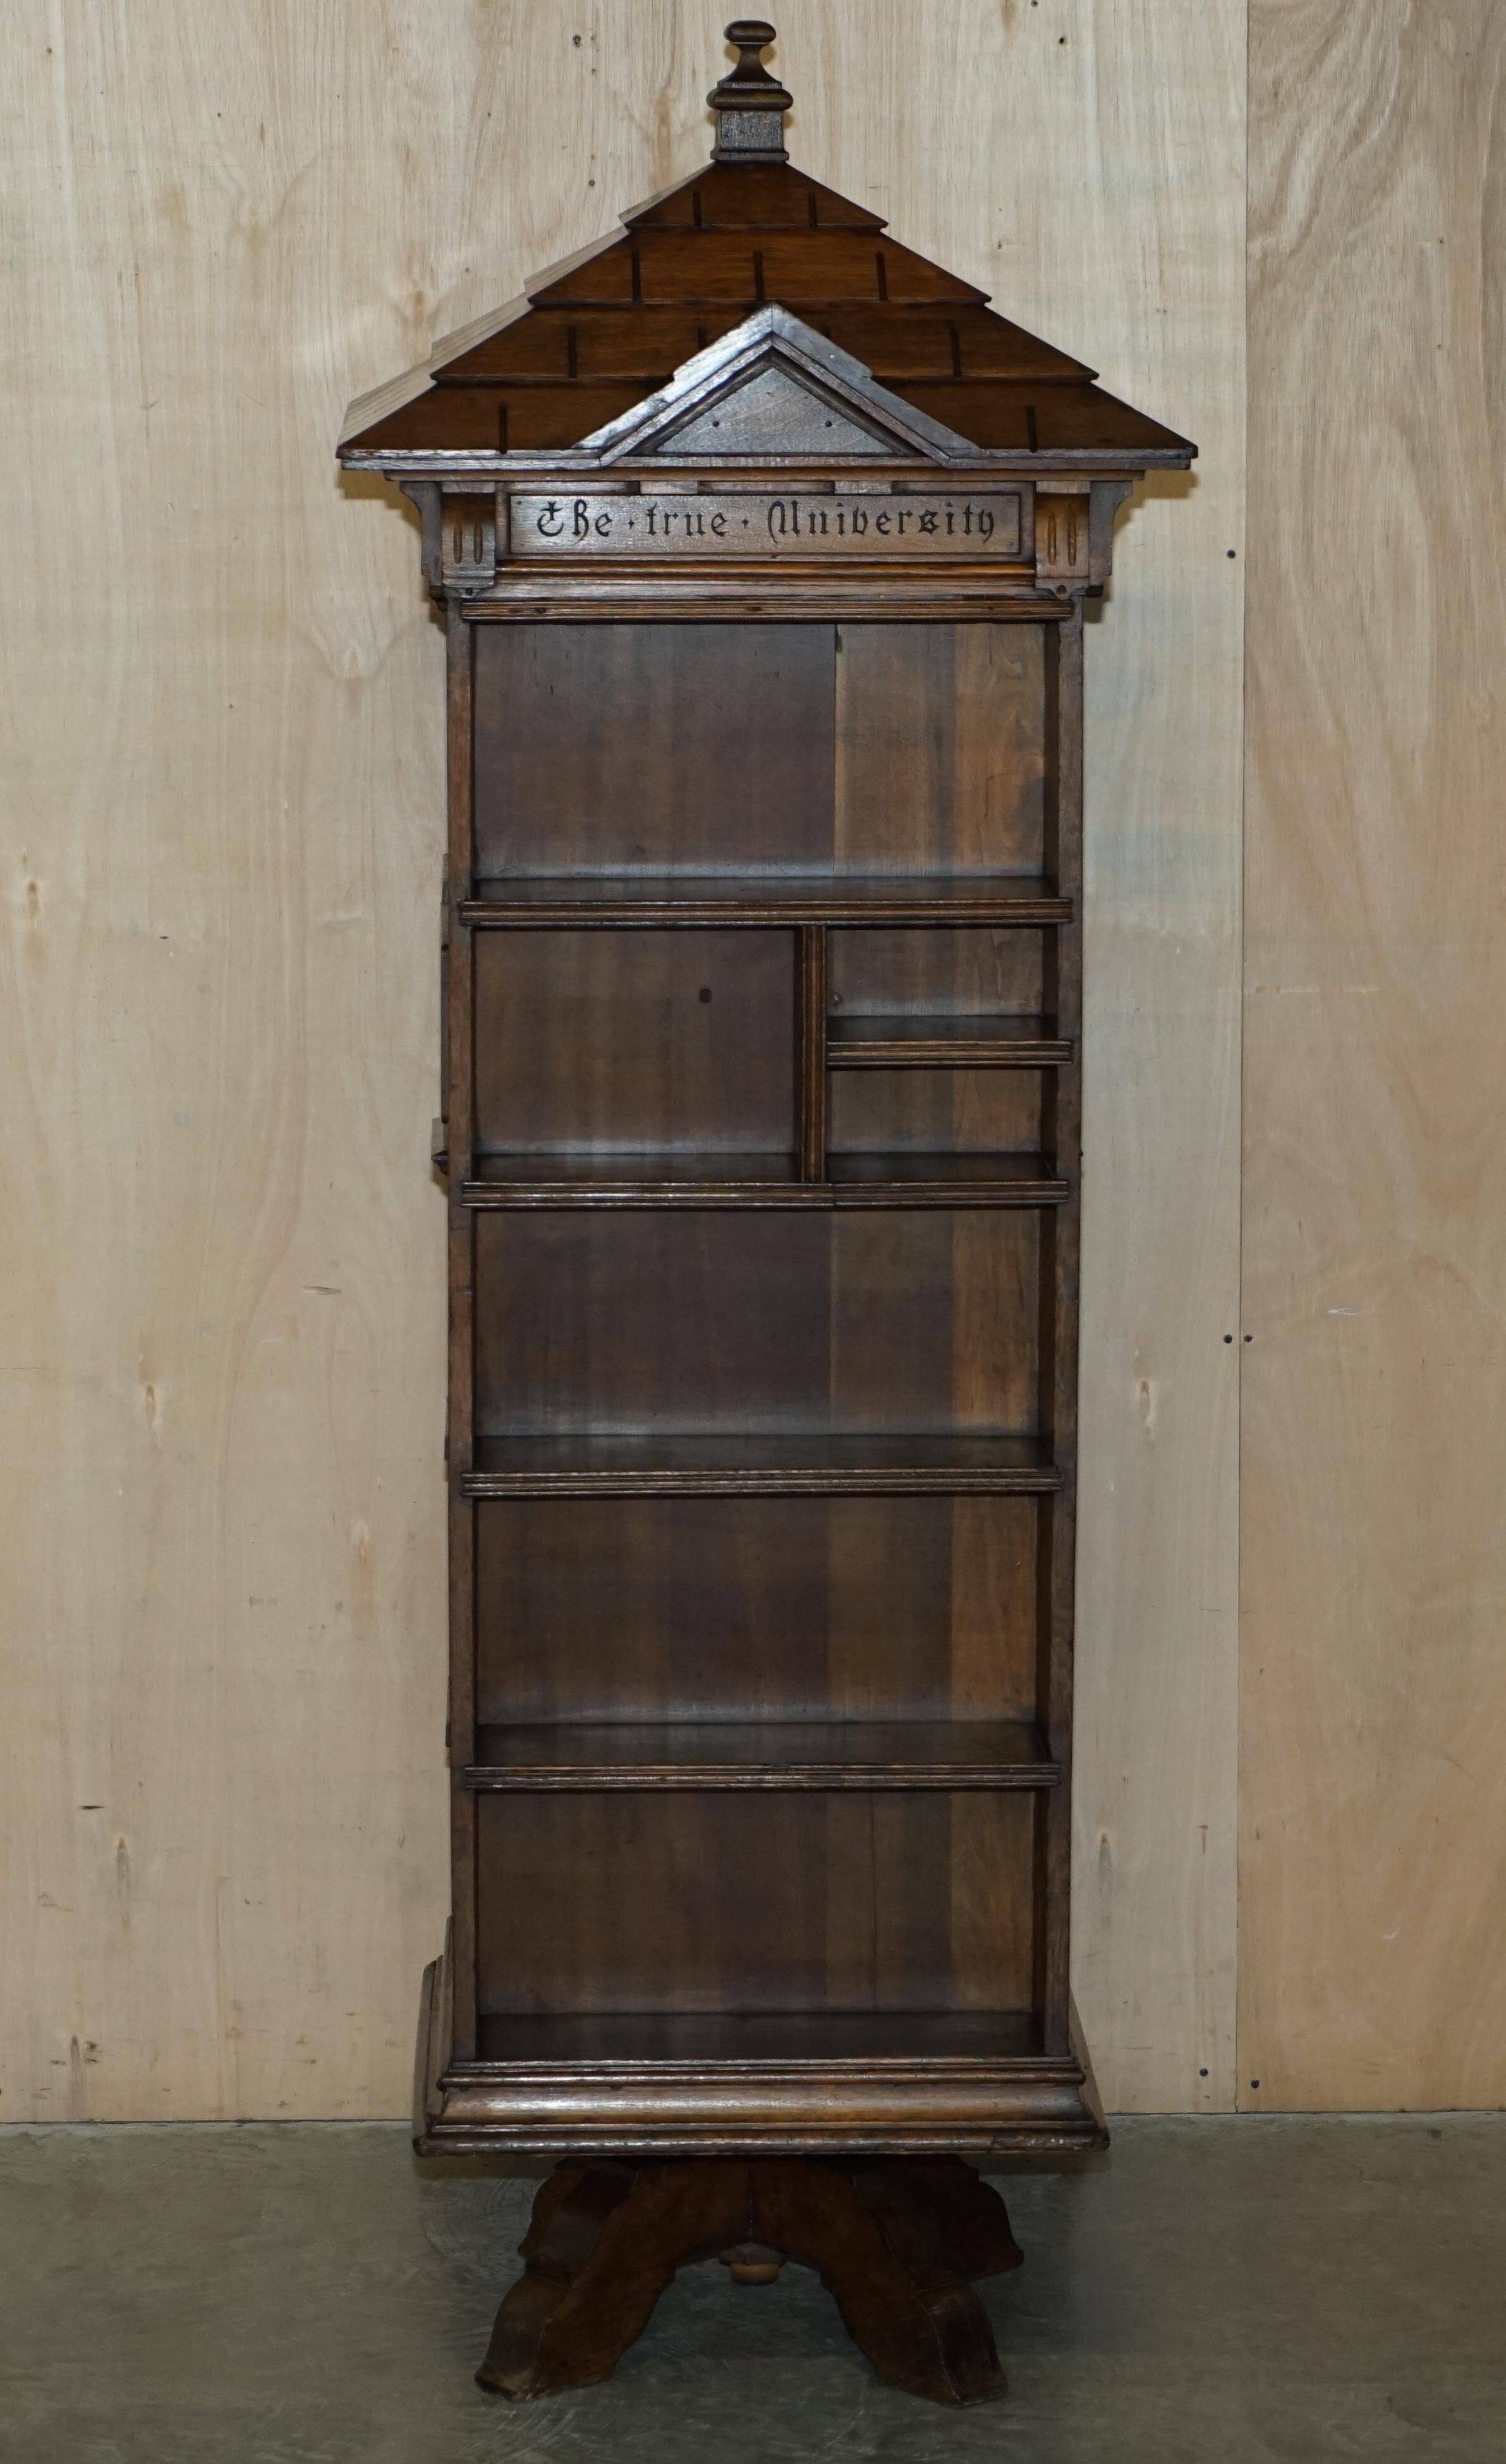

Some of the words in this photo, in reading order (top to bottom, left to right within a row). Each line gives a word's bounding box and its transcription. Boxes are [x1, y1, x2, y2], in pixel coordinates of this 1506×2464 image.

[537, 499, 612, 546] The
[645, 502, 728, 537] true
[767, 500, 994, 549] University
